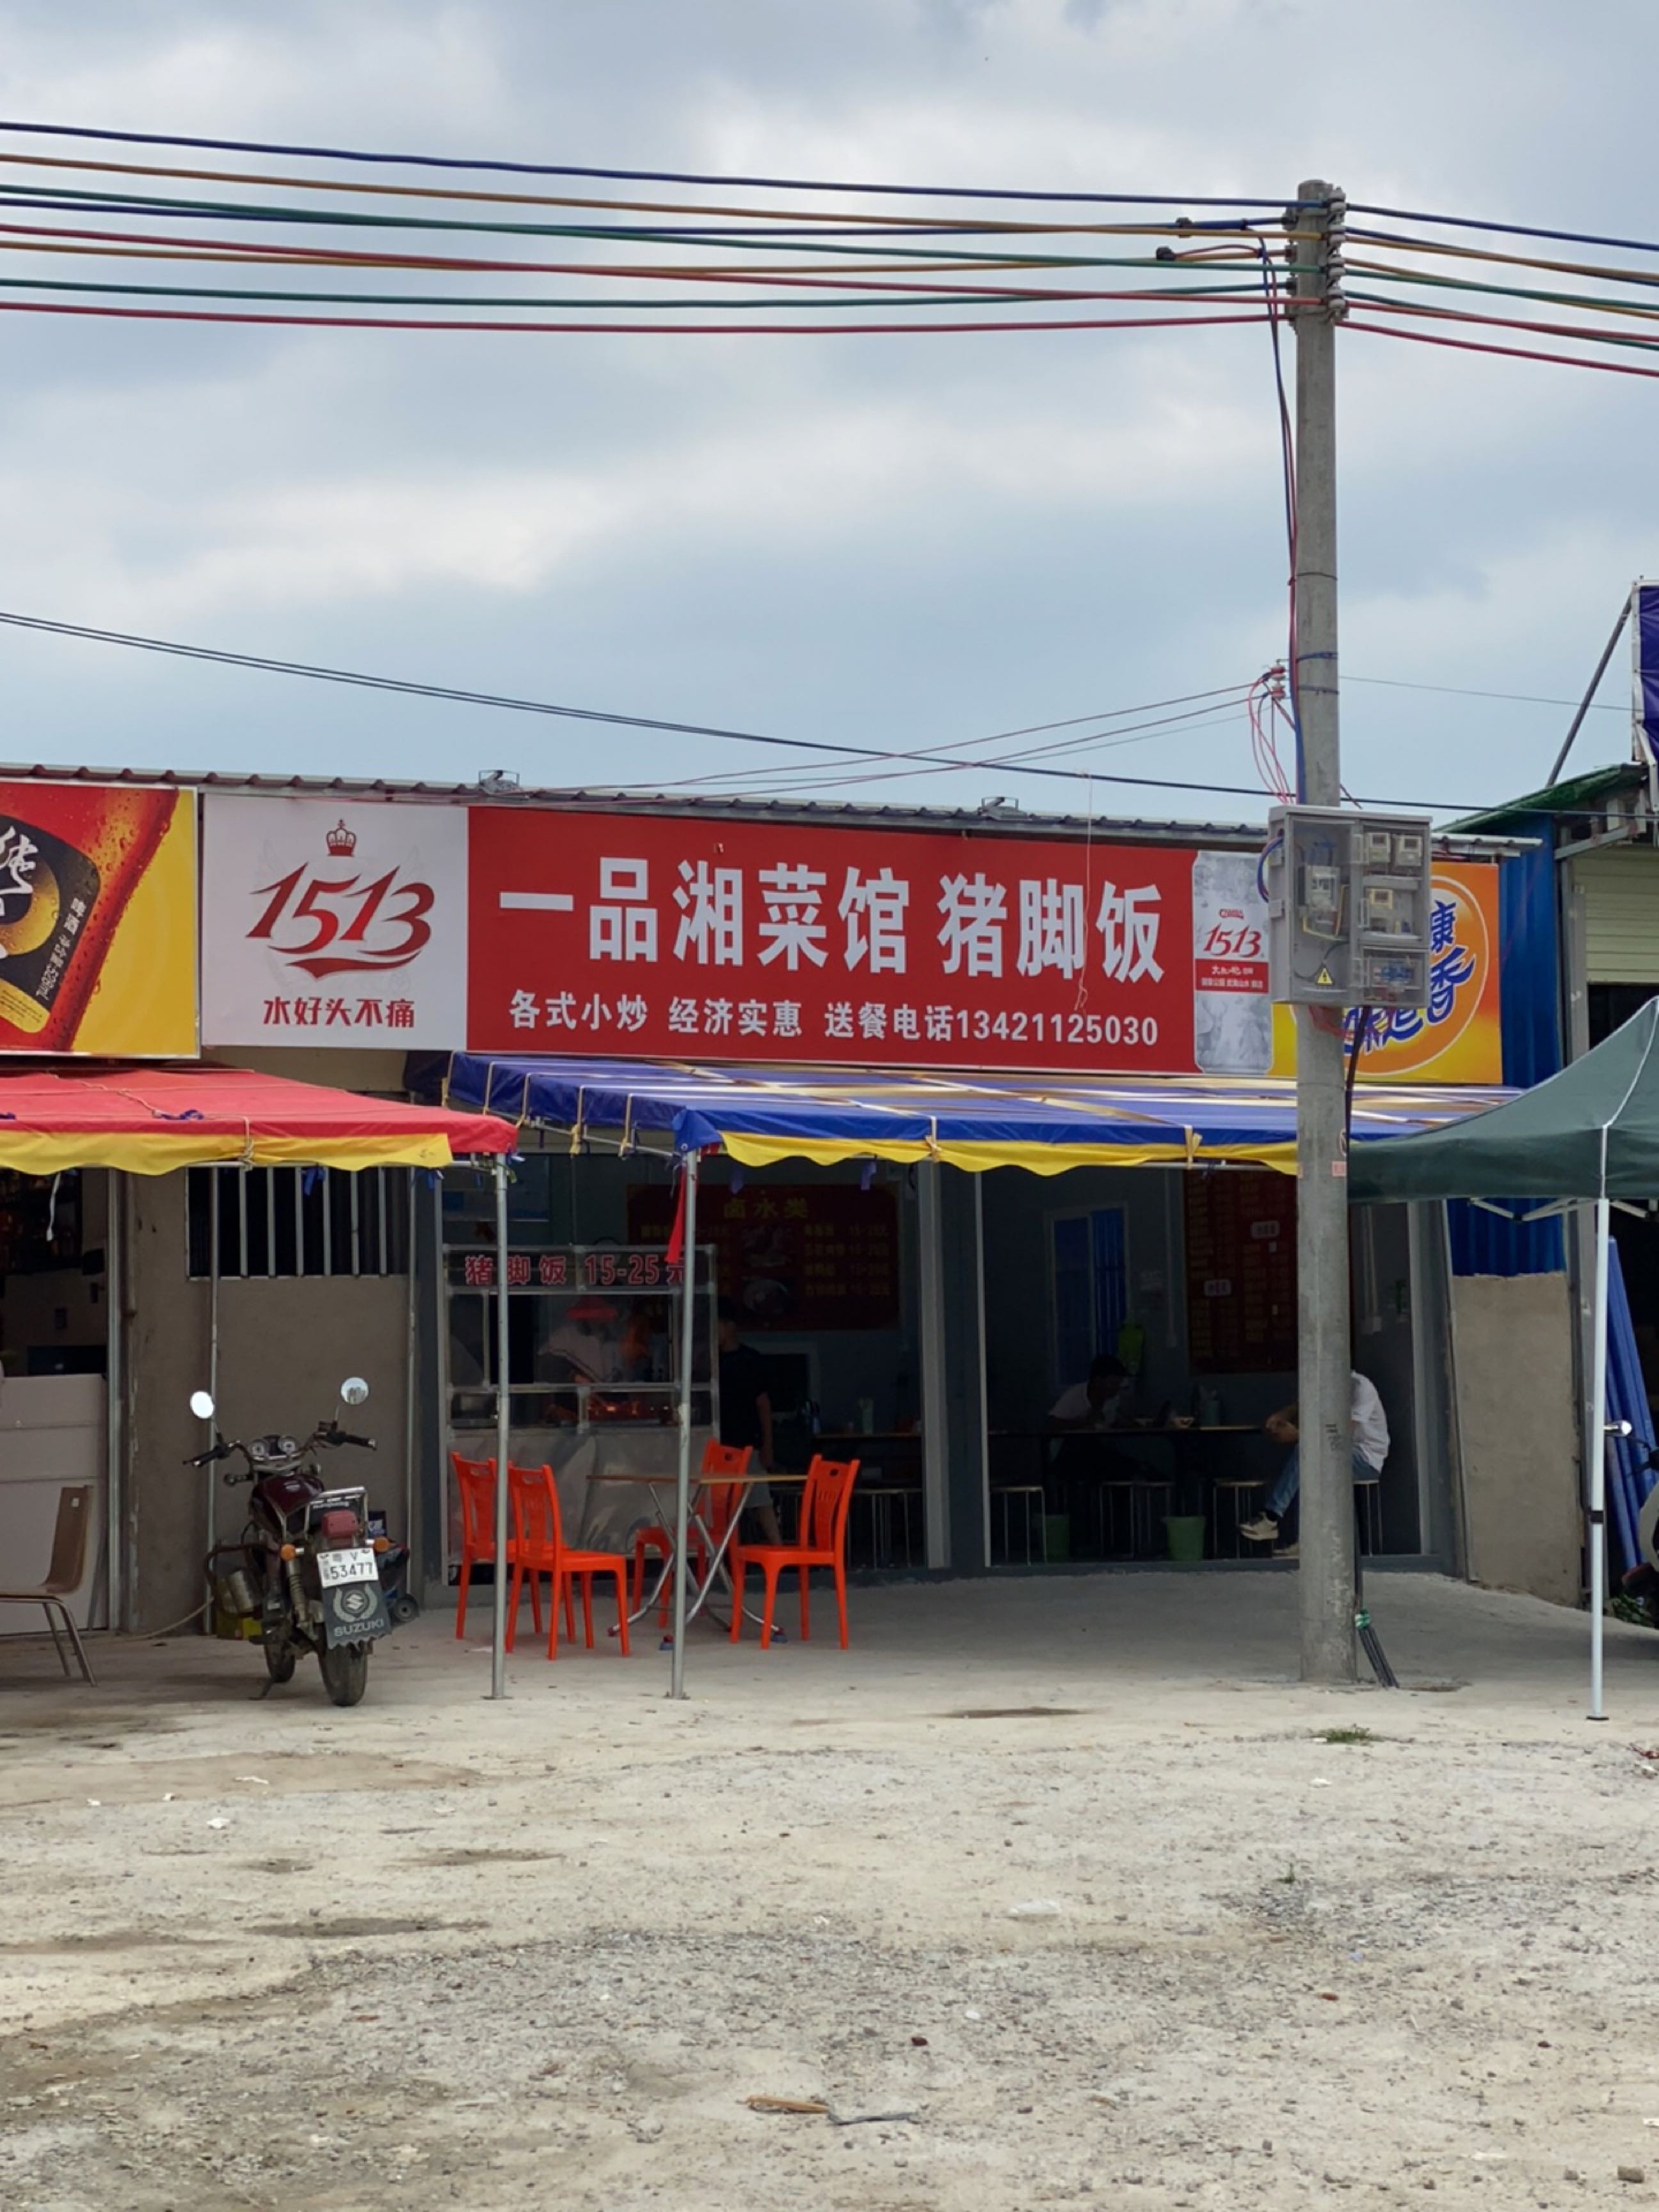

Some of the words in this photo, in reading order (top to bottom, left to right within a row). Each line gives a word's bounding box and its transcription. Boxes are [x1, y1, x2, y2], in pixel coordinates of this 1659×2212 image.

[245, 862, 435, 957] 1513
[499, 856, 910, 974] 一品湘菜馆
[937, 872, 1164, 982] 猪脚饭
[1203, 922, 1262, 958] 1513
[262, 996, 415, 1028] 水好头不痛
[509, 989, 648, 1032] 各式小炒
[668, 996, 802, 1037] 经济实惠
[824, 1002, 1158, 1045] 送餐电话13421125030
[465, 1254, 567, 1285] 猪脚饭
[330, 1562, 373, 1580] 53477
[333, 1619, 383, 1637] SUZUKI
